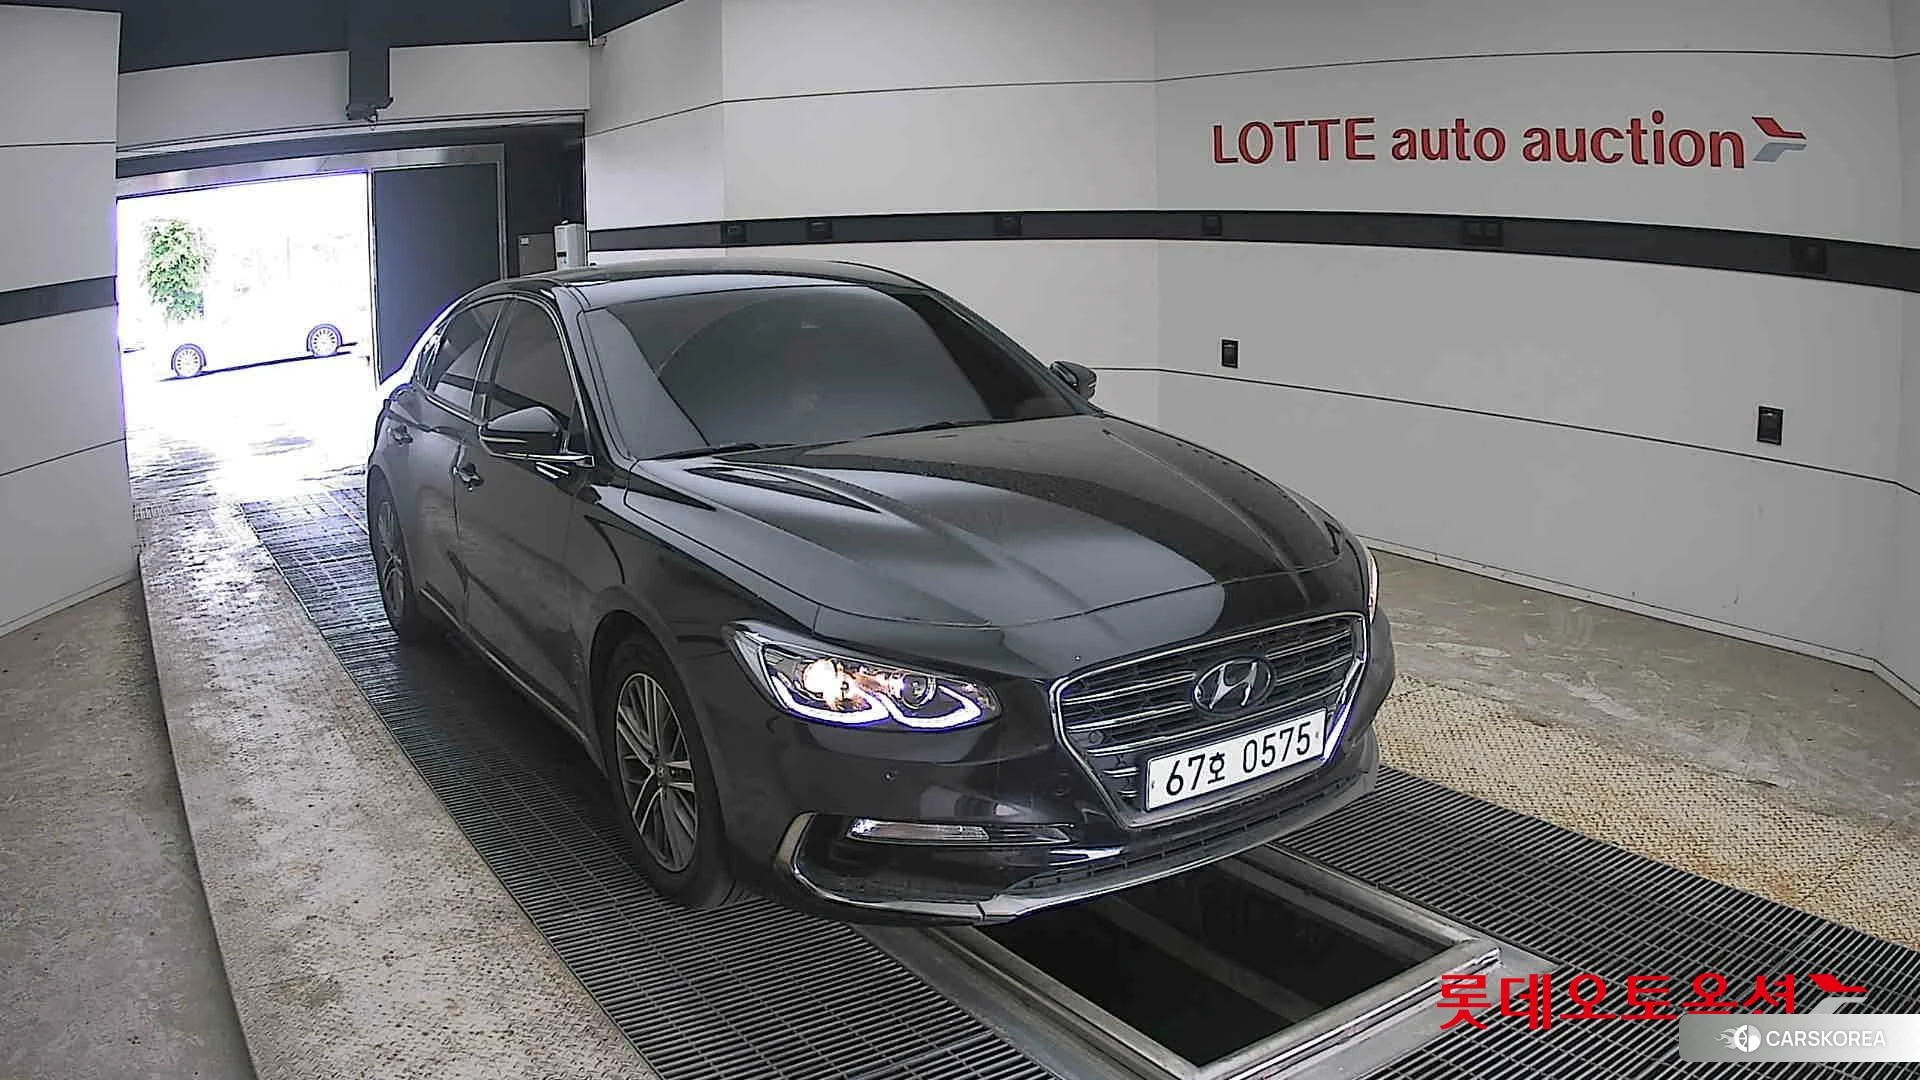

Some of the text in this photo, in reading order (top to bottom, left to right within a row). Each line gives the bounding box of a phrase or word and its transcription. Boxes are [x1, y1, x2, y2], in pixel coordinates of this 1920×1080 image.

[1213, 110, 1744, 168] LOTTE auto auction
[1165, 721, 1312, 796] 67호 0575
